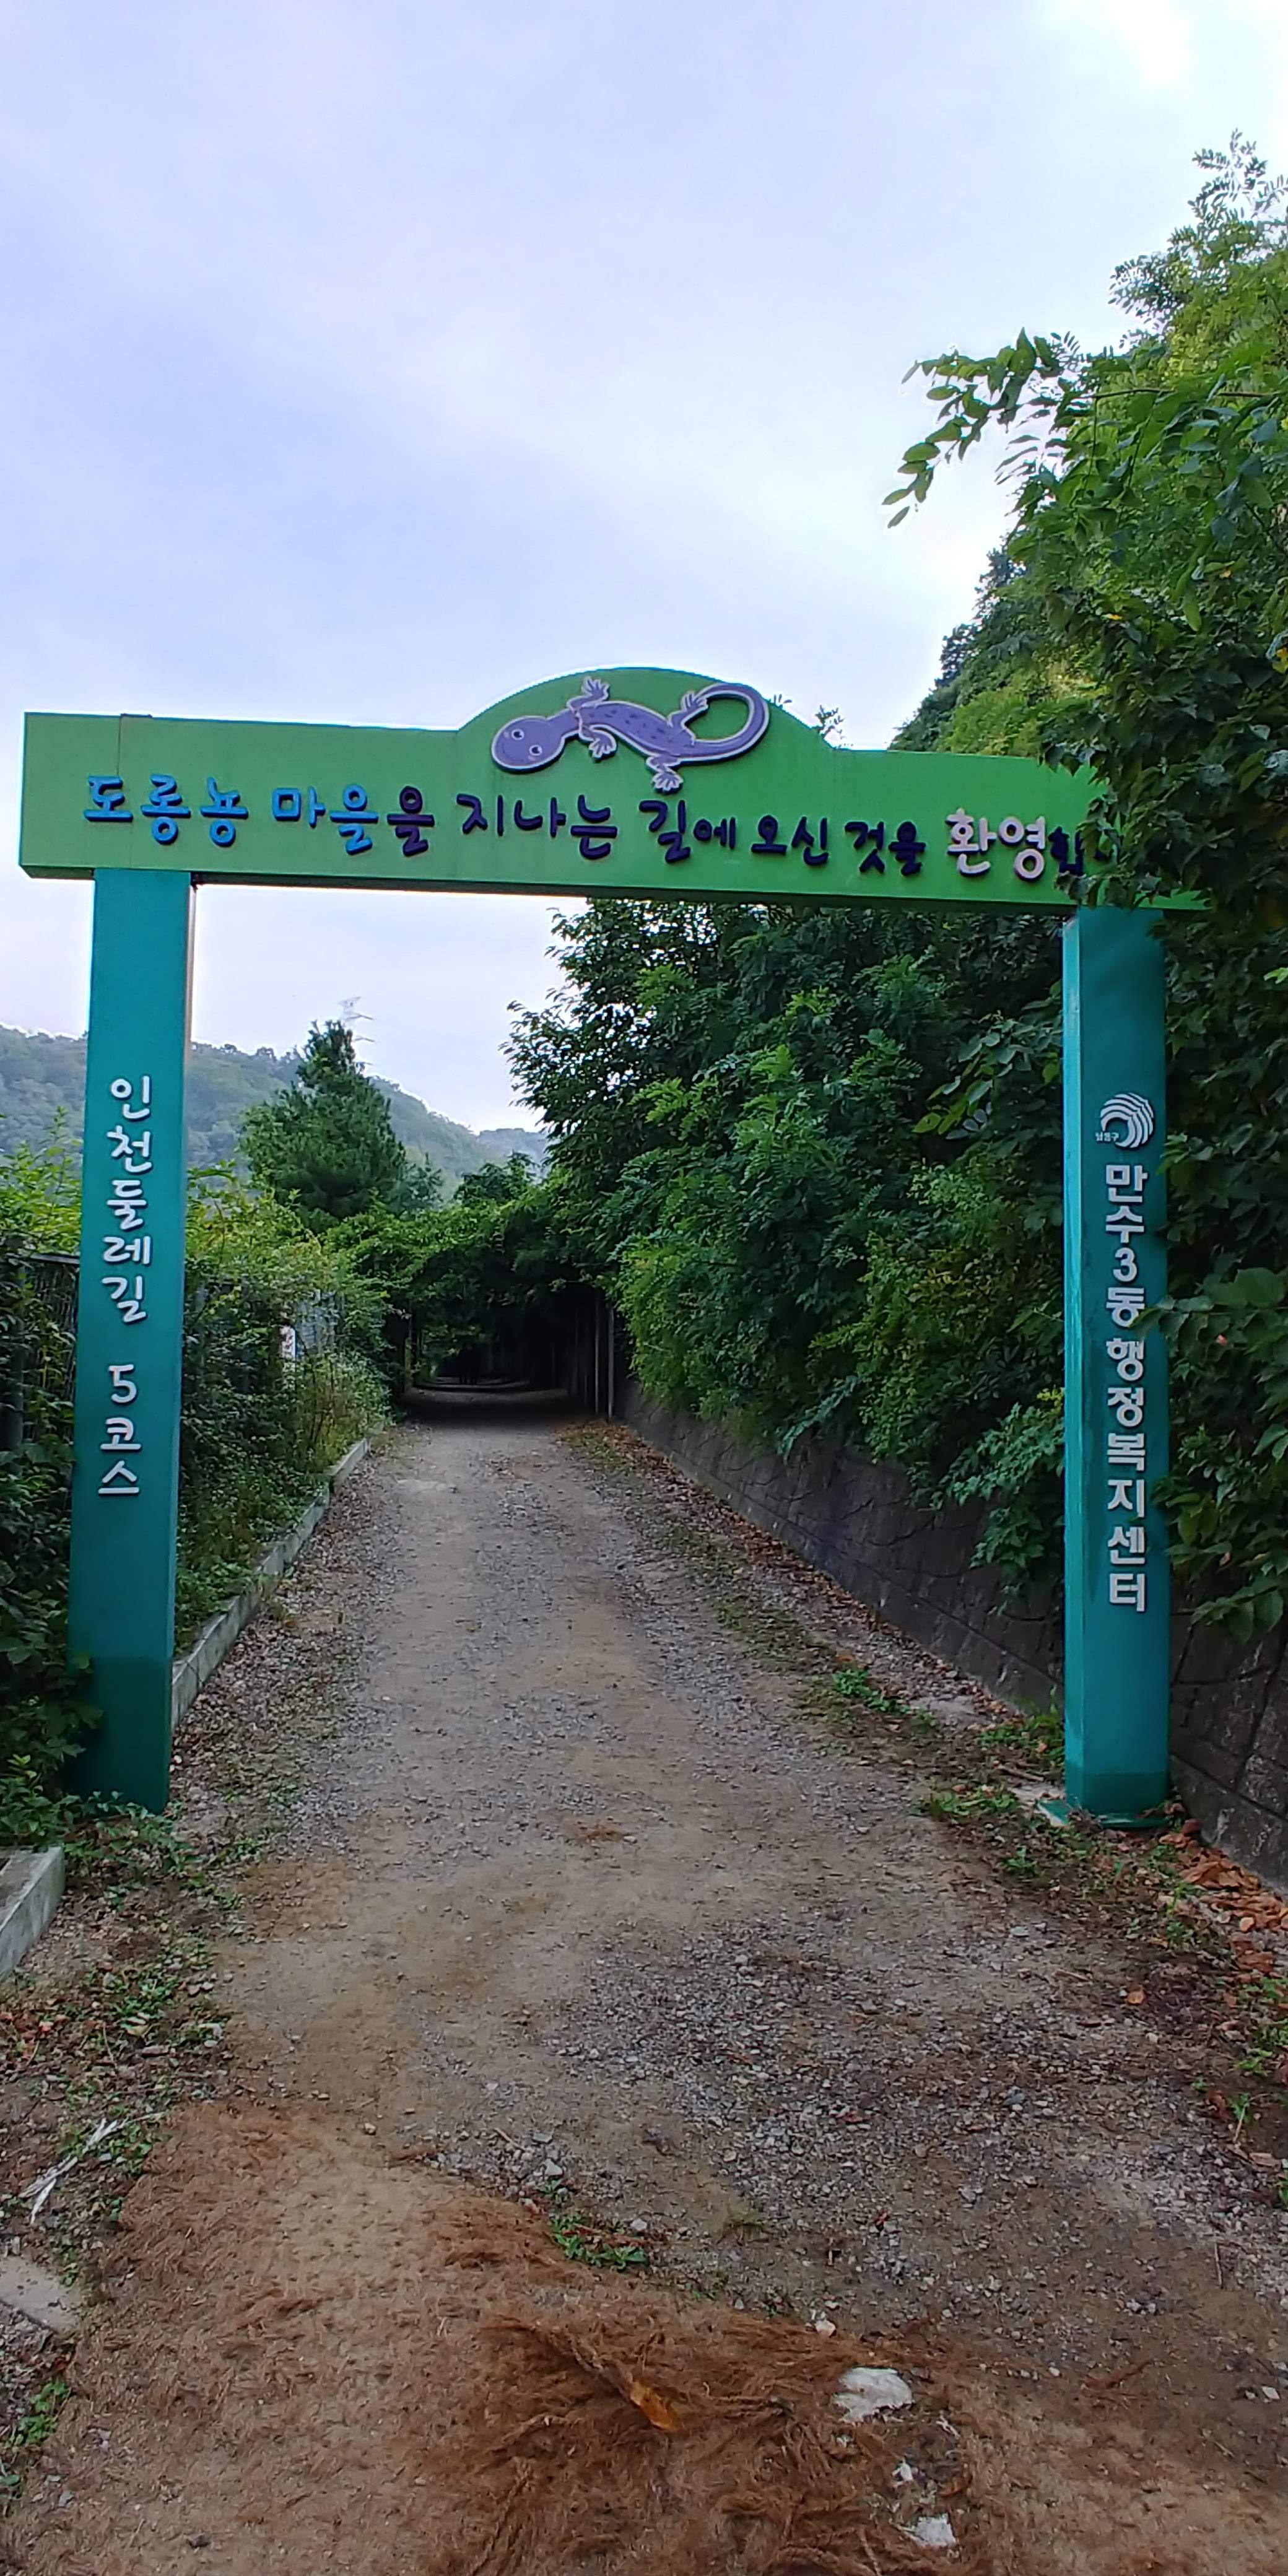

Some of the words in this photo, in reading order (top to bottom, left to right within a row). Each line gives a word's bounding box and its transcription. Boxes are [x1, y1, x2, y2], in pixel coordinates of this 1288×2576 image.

[84, 773, 249, 847] 도롱뇽
[272, 783, 435, 856] 마을을
[456, 794, 618, 860] 지나는
[638, 799, 736, 864] 길에
[751, 816, 829, 866] 오신
[844, 820, 926, 876] 것을
[101, 1074, 152, 1325] 인천둘레길
[97, 1363, 142, 1497] 5코스
